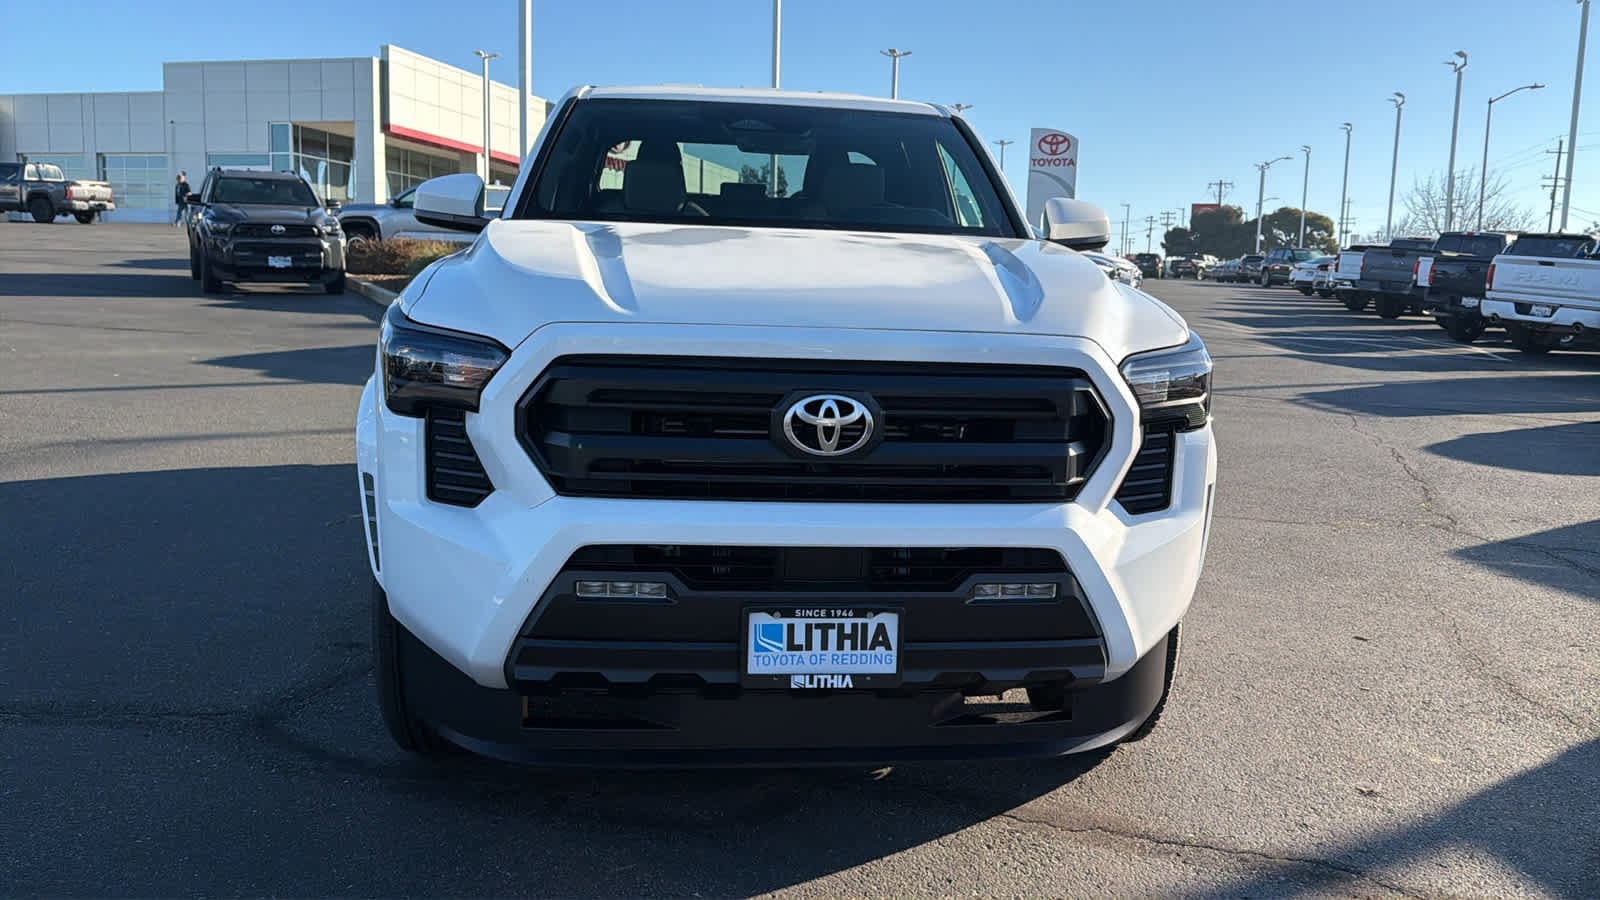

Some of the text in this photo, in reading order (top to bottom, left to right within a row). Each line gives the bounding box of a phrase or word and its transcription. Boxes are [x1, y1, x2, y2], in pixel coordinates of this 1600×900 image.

[1031, 158, 1075, 167] TOYOTA
[794, 609, 854, 618] SINCE 1946
[786, 623, 893, 652] LITHIA
[753, 653, 893, 667] TOYOTA OF REDDING
[805, 675, 854, 689] LITHIA
